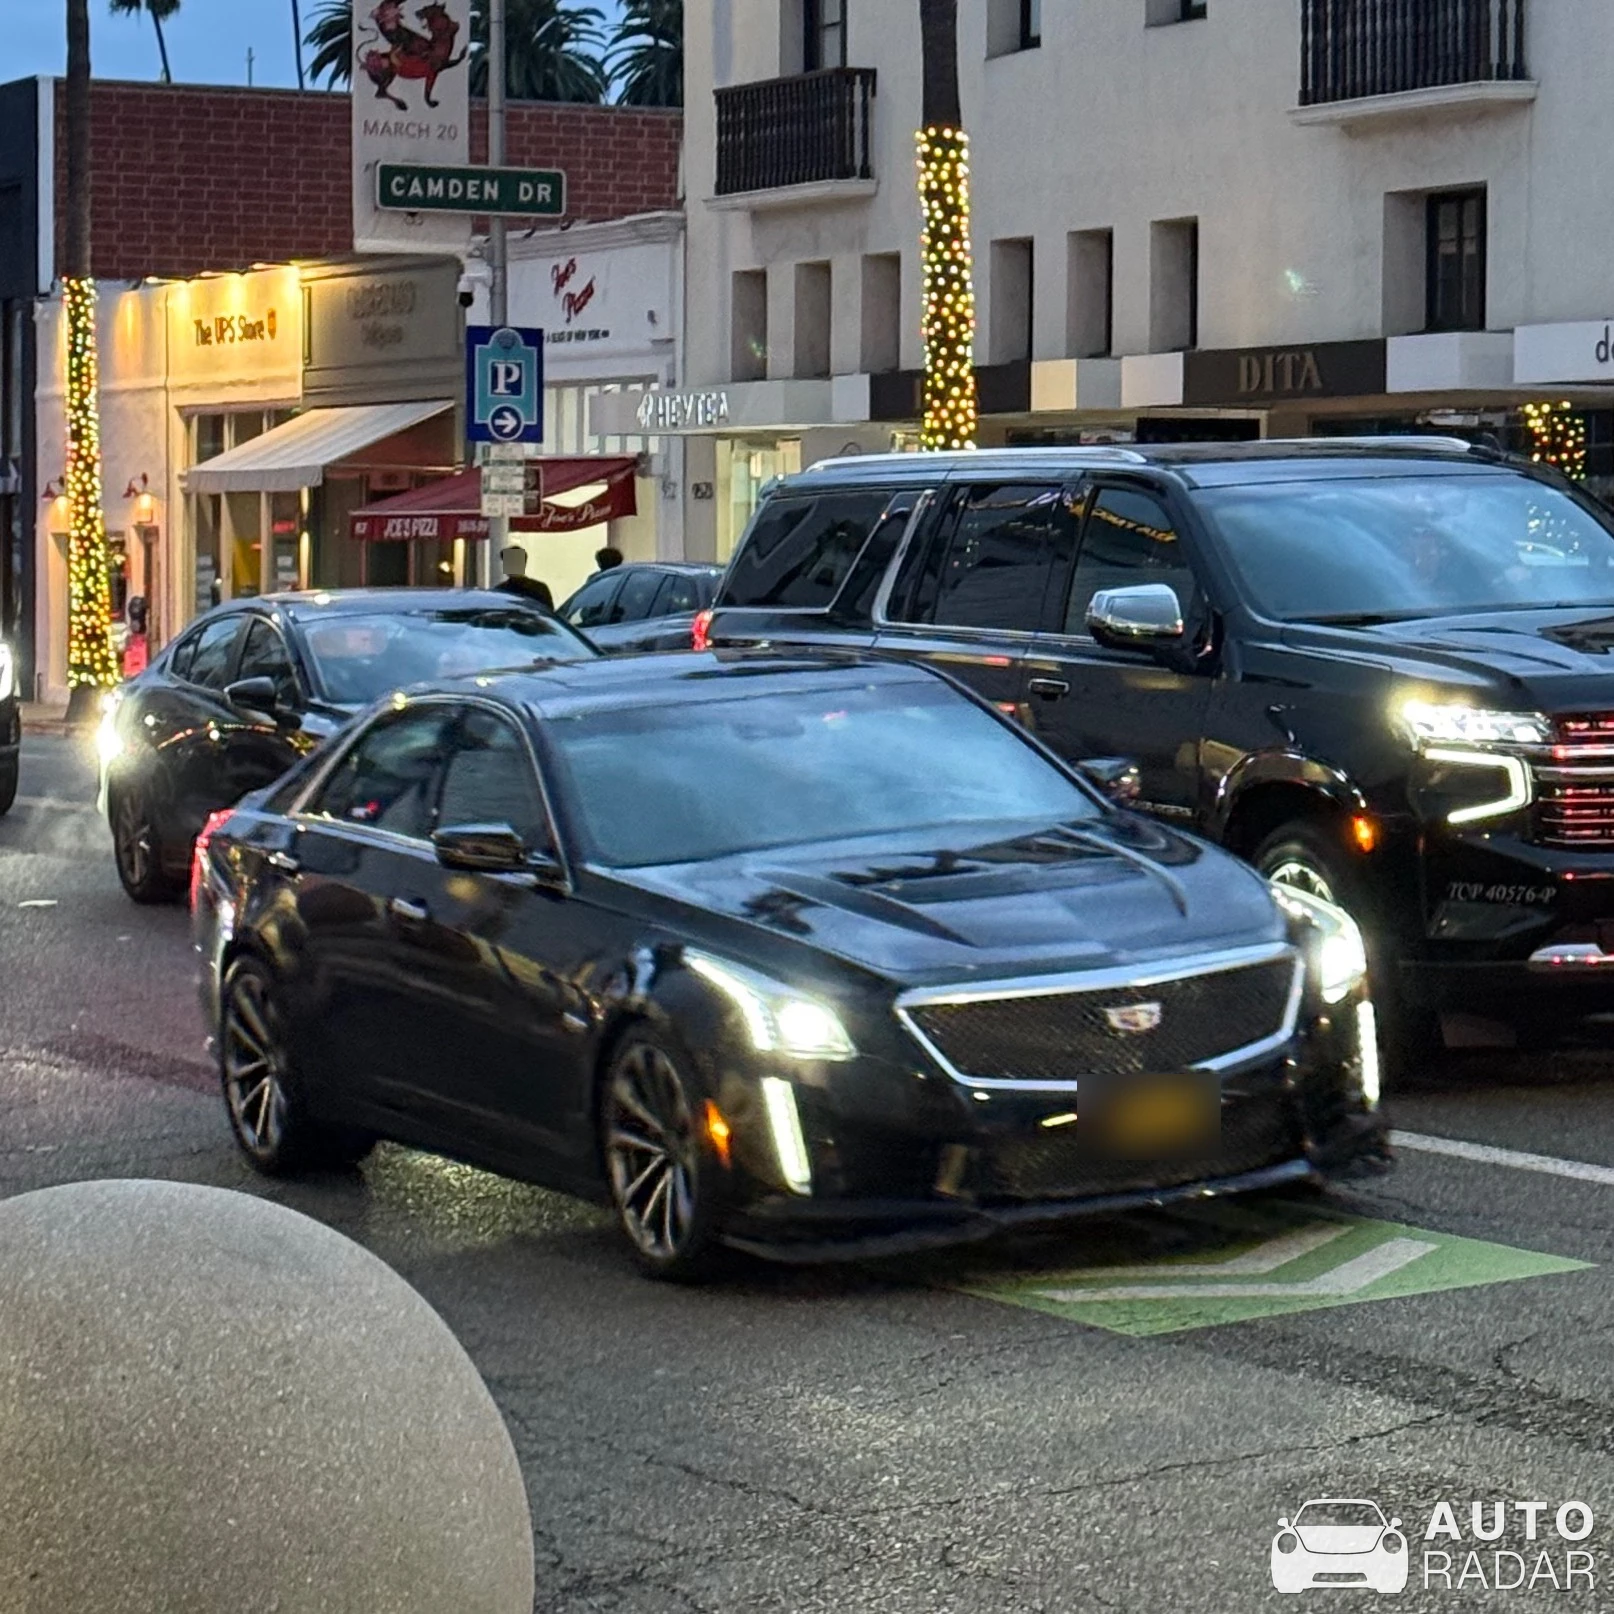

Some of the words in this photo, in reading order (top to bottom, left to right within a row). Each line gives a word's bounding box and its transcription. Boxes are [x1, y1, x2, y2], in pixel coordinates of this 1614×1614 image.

[363, 120, 430, 138] MARCH
[437, 124, 458, 141] 20
[390, 175, 498, 200] CAMDEN
[518, 181, 551, 203] DR
[194, 318, 212, 346] The
[214, 315, 236, 344] UPS
[238, 315, 265, 342] Store
[1595, 324, 1614, 363] d
[493, 362, 520, 394] P
[1238, 351, 1323, 393] DITA
[657, 392, 730, 428] HEYTEA
[1449, 881, 1484, 901] TCP
[1486, 884, 1556, 904] 40576-P
